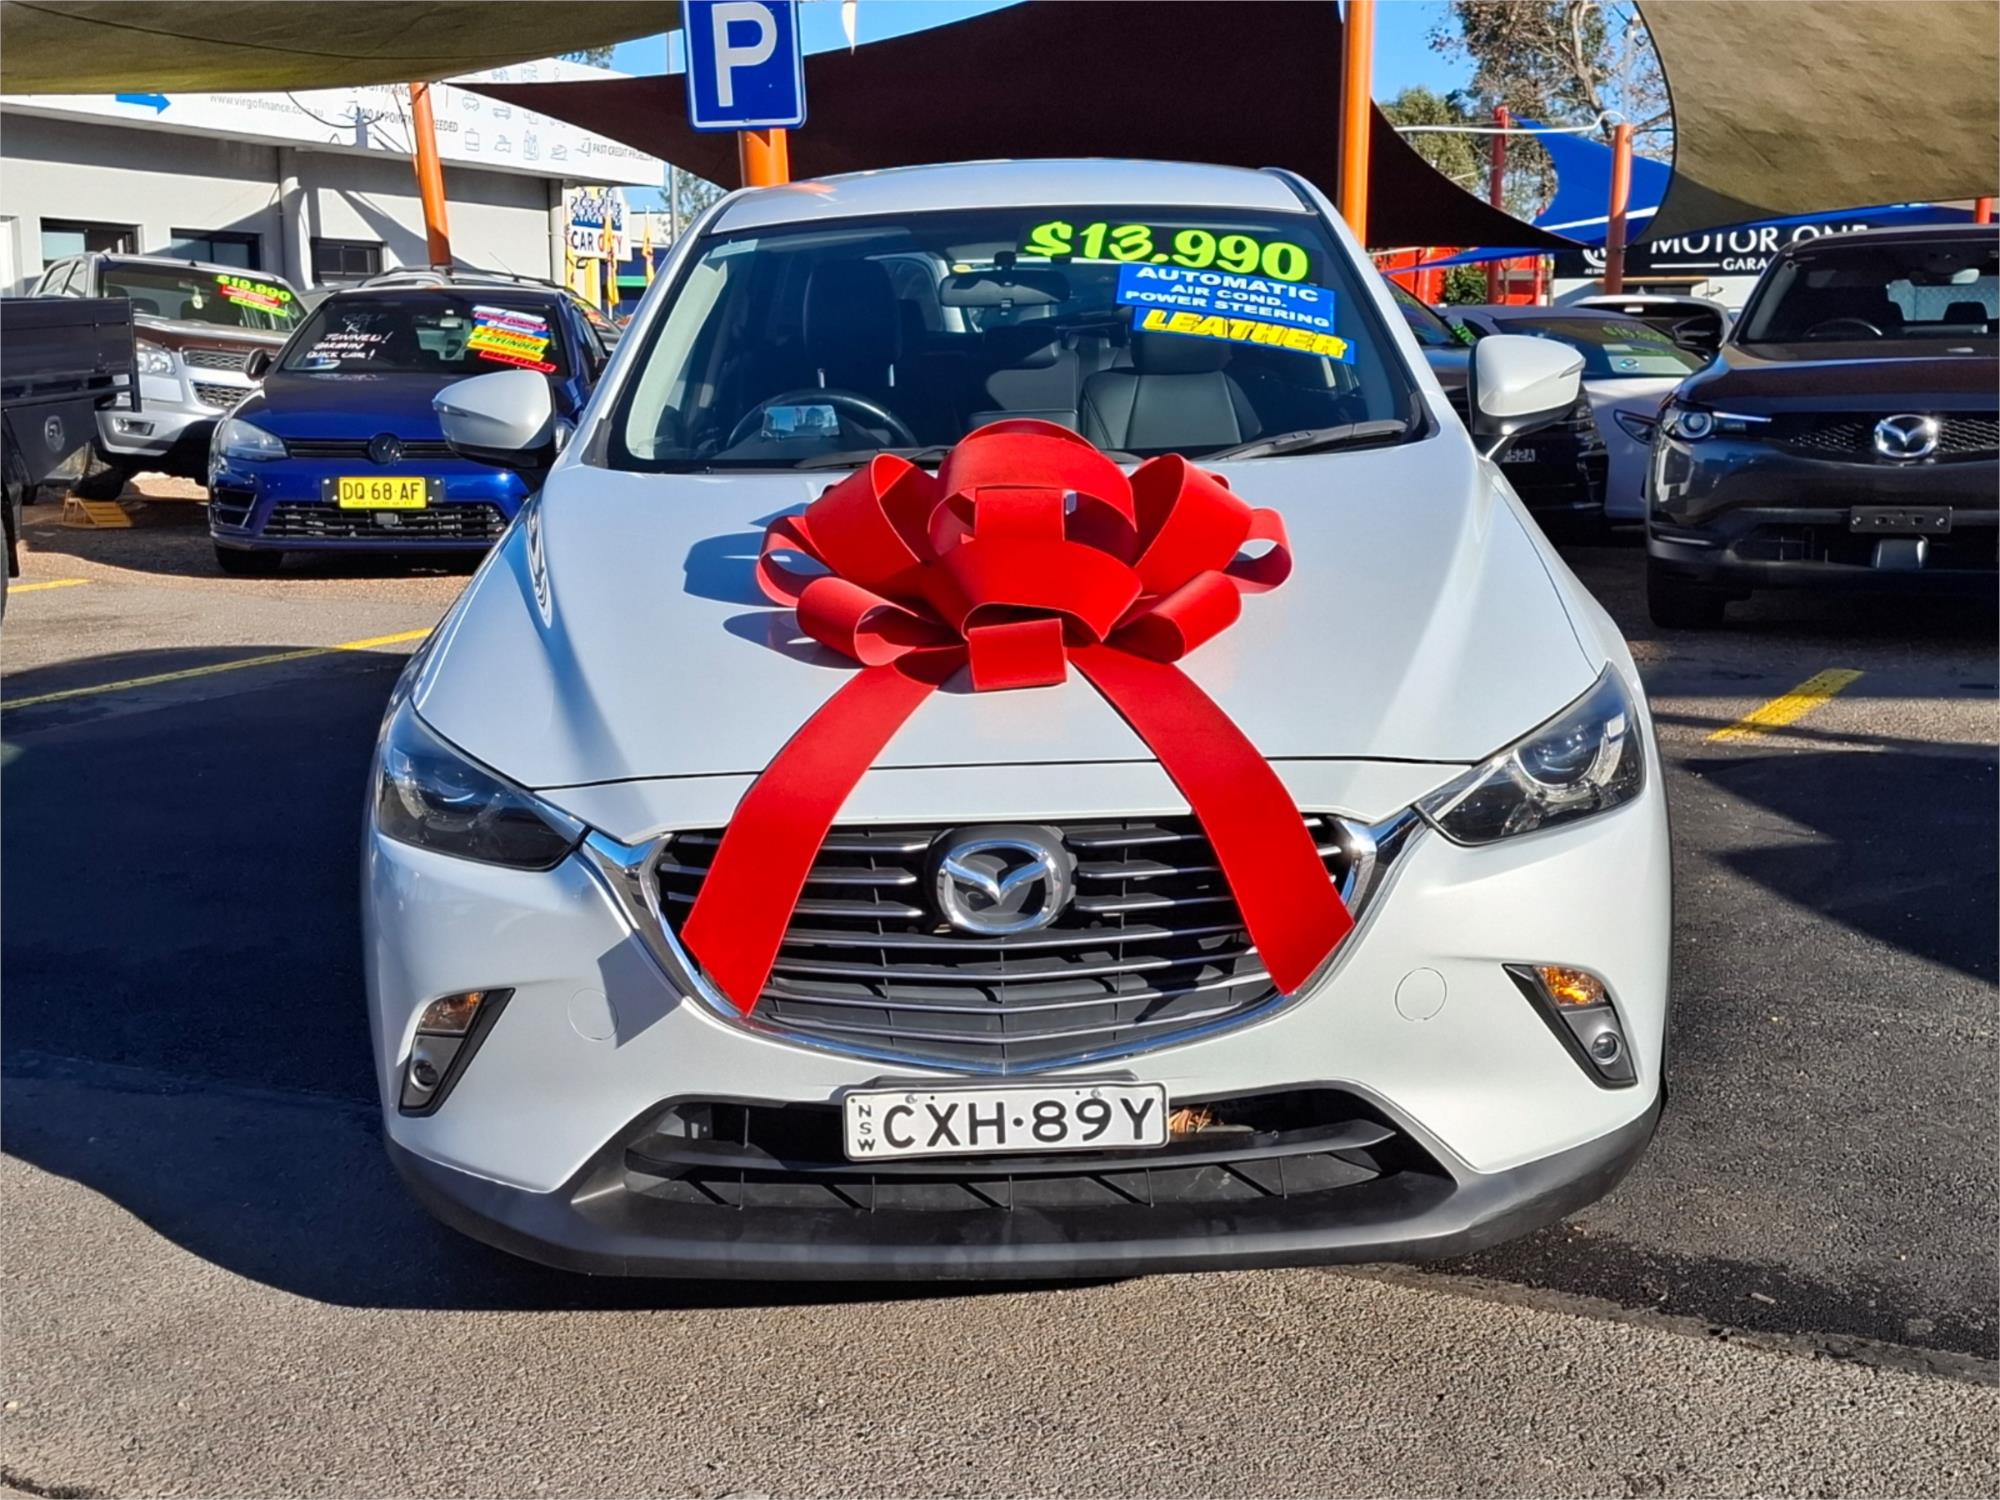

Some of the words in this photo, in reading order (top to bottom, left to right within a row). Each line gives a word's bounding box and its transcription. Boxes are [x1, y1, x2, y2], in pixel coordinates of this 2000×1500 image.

[711, 1, 777, 107] P
[434, 119, 459, 132] EEDED
[571, 230, 594, 251] CAR
[1024, 221, 1309, 282] $13.990
[1650, 226, 1779, 254] MOTOR
[1135, 265, 1320, 302] AUTOMATIC
[1170, 284, 1210, 297] AIR
[1216, 288, 1288, 309] COND.
[1125, 289, 1204, 308] POWER
[1214, 300, 1331, 328] STEERING
[1141, 308, 1350, 360] LEATHER
